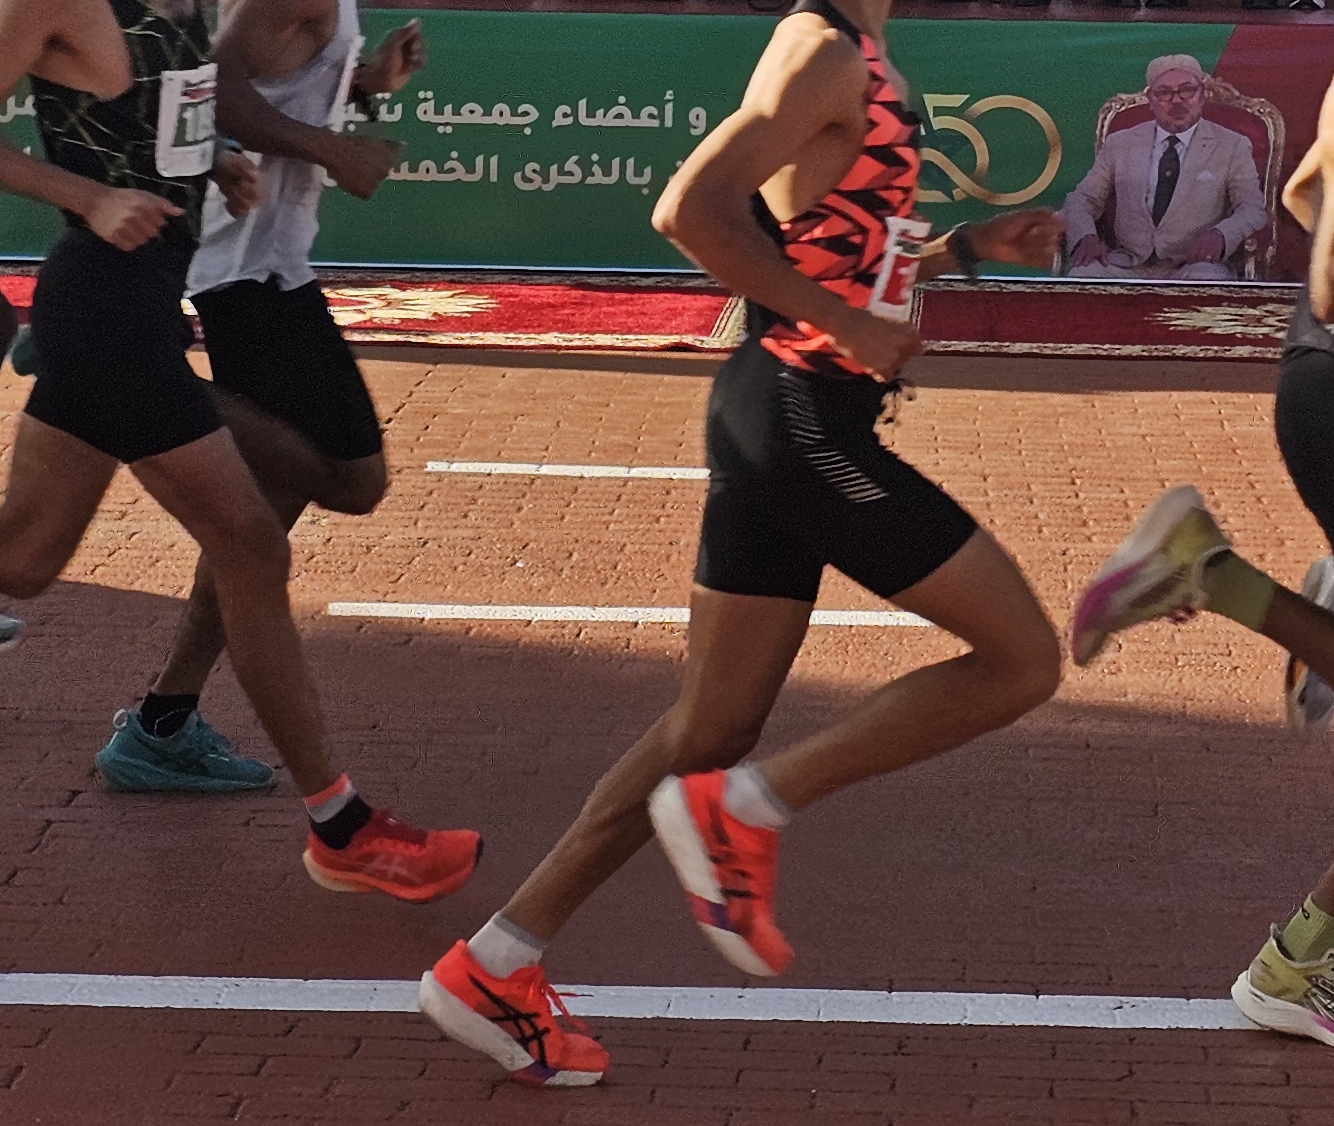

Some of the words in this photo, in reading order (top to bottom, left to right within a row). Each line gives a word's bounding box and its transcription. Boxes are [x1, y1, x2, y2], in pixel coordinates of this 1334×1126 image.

[415, 90, 540, 136] جمعية
[551, 89, 675, 128] أعضاء
[513, 152, 652, 195] بالذكرى
